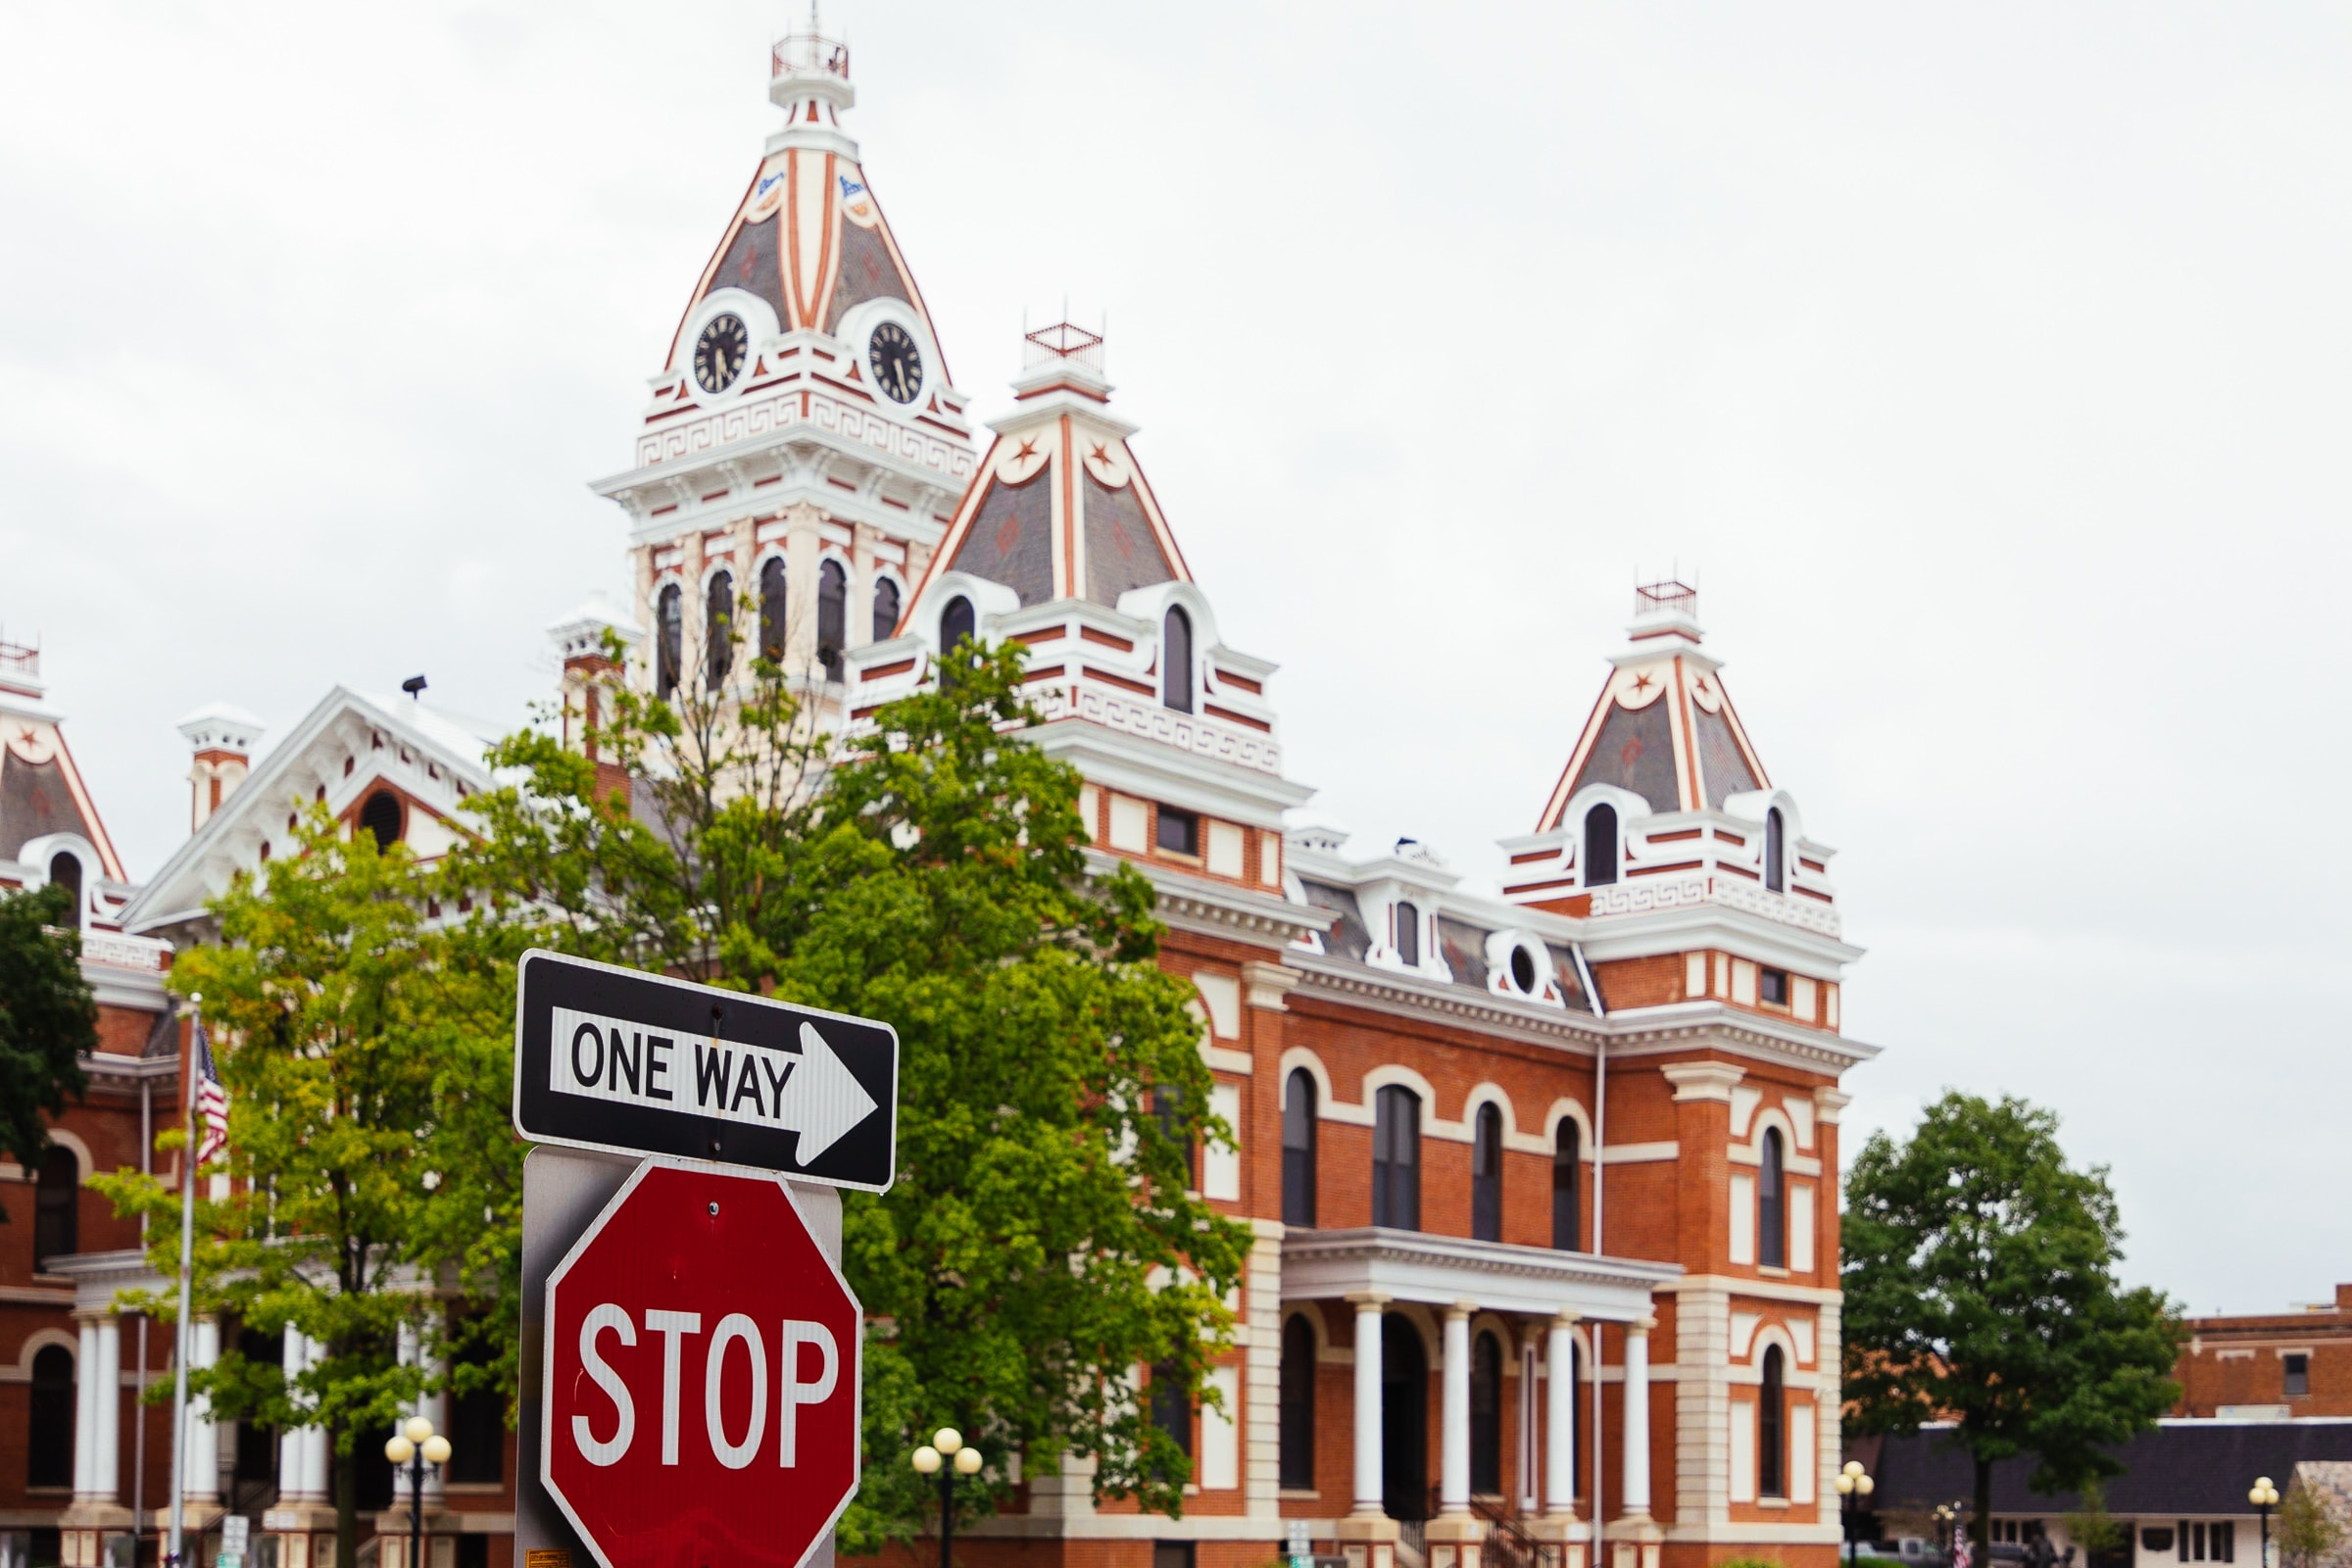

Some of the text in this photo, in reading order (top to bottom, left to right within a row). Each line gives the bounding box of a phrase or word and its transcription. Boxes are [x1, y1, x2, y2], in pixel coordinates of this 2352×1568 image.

[571, 1022, 796, 1119] ONE WAY
[571, 1302, 839, 1470] STOP
